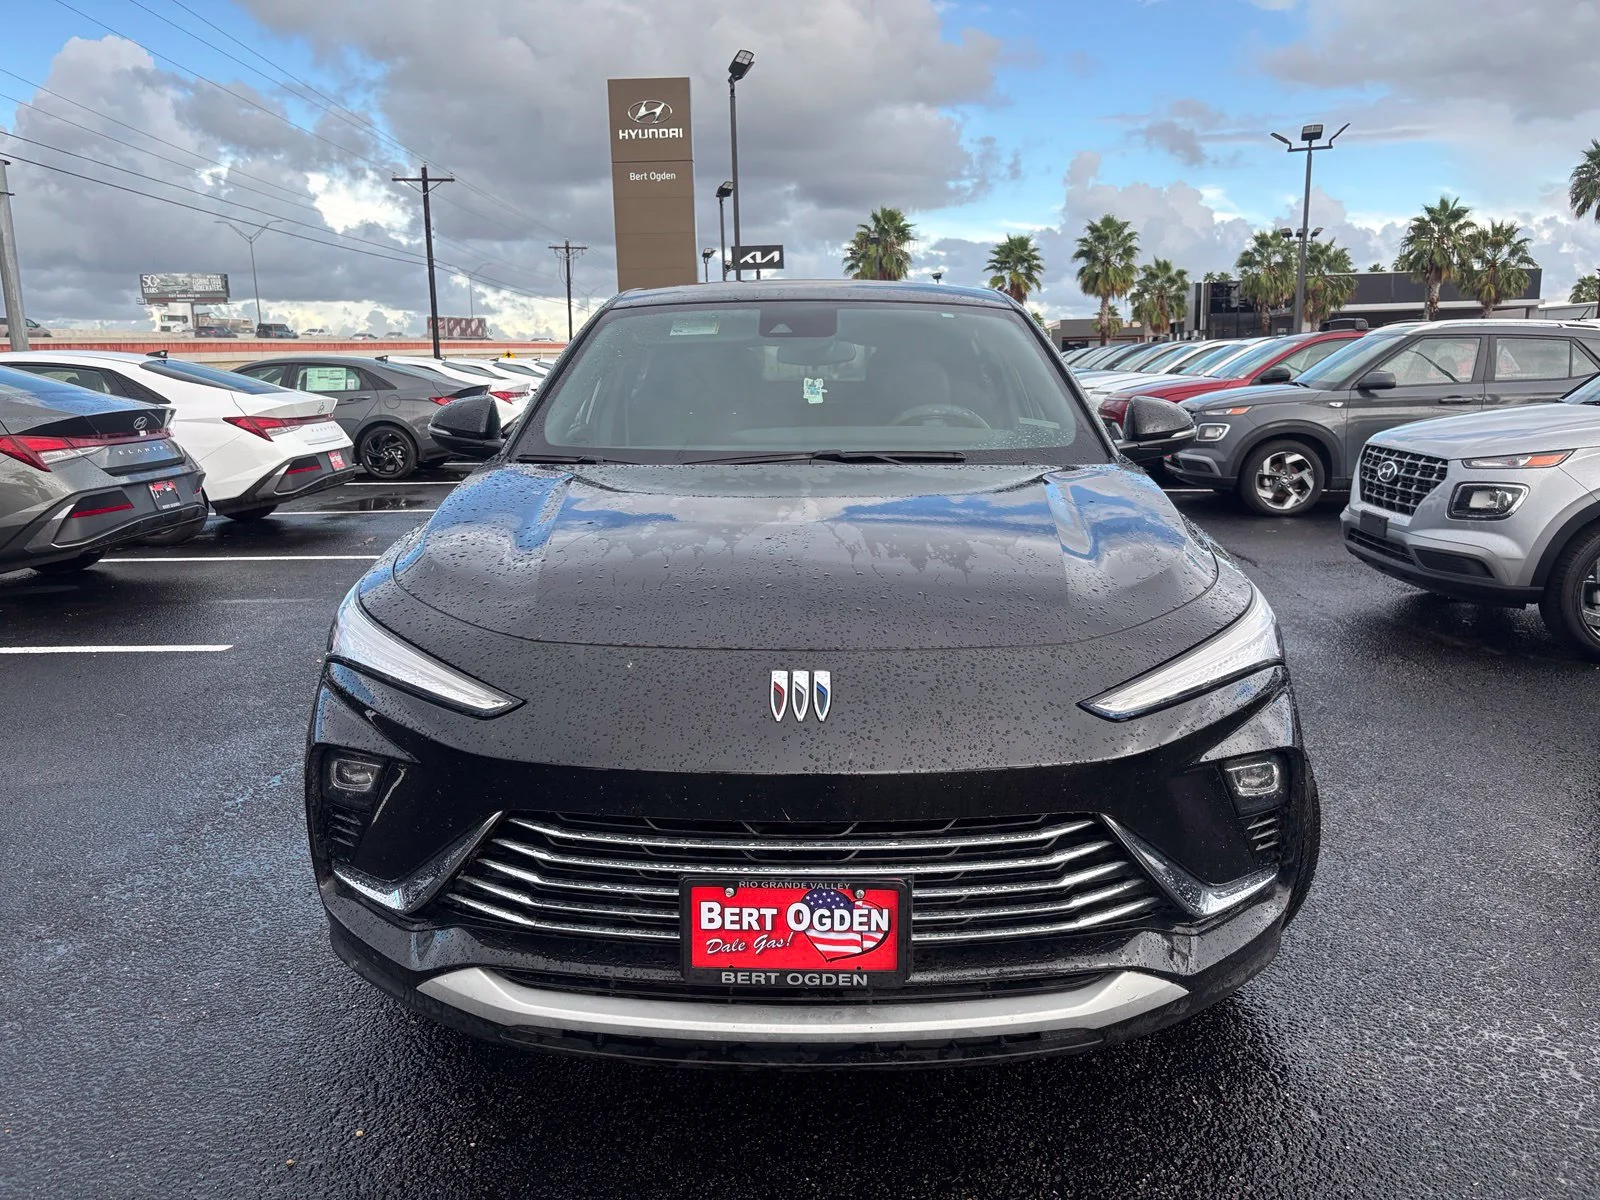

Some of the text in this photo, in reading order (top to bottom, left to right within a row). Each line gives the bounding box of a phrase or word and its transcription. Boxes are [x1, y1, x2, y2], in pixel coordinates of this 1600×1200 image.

[618, 127, 684, 140] HYUNDAI
[629, 171, 676, 182] Bert Ogden
[739, 880, 851, 890] RIO GRANDE VALLEY
[699, 901, 889, 932] BERT OGDEN
[706, 931, 794, 955] Dale Gas!
[721, 971, 868, 986] BERT OGDEN
